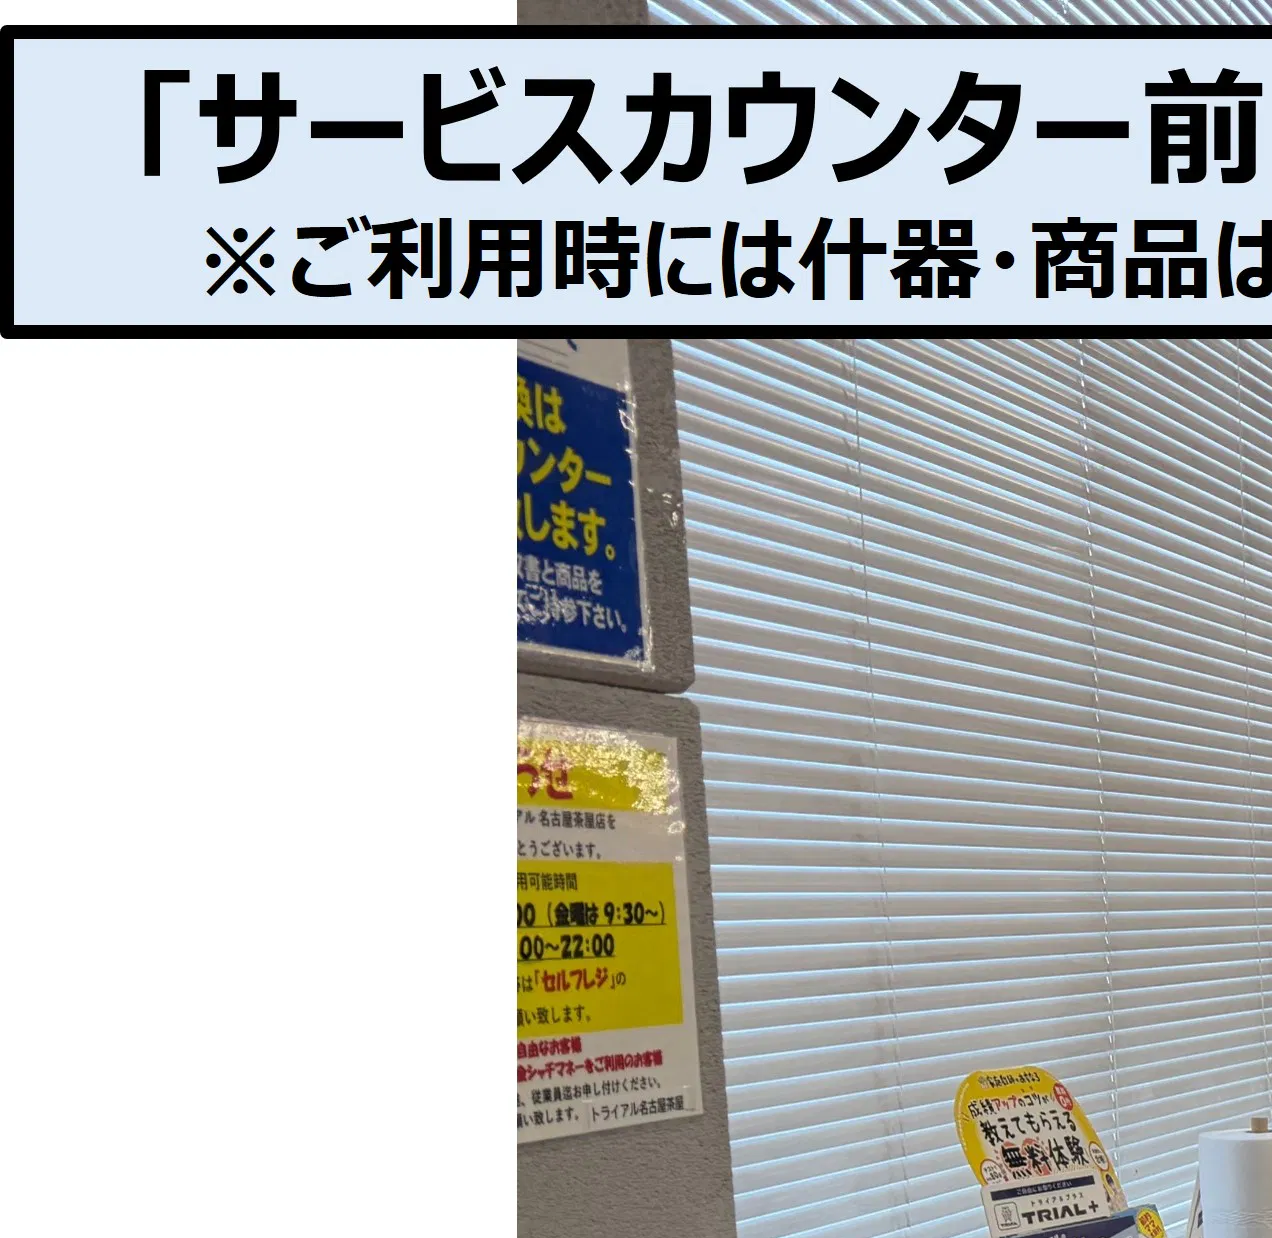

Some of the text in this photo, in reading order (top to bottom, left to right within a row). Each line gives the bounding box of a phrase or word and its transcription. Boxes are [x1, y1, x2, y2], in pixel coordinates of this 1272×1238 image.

[517, 492, 617, 561] します。
[979, 1110, 1077, 1147] 教えてもらえる
[1001, 1134, 1089, 1173] 無料体験
